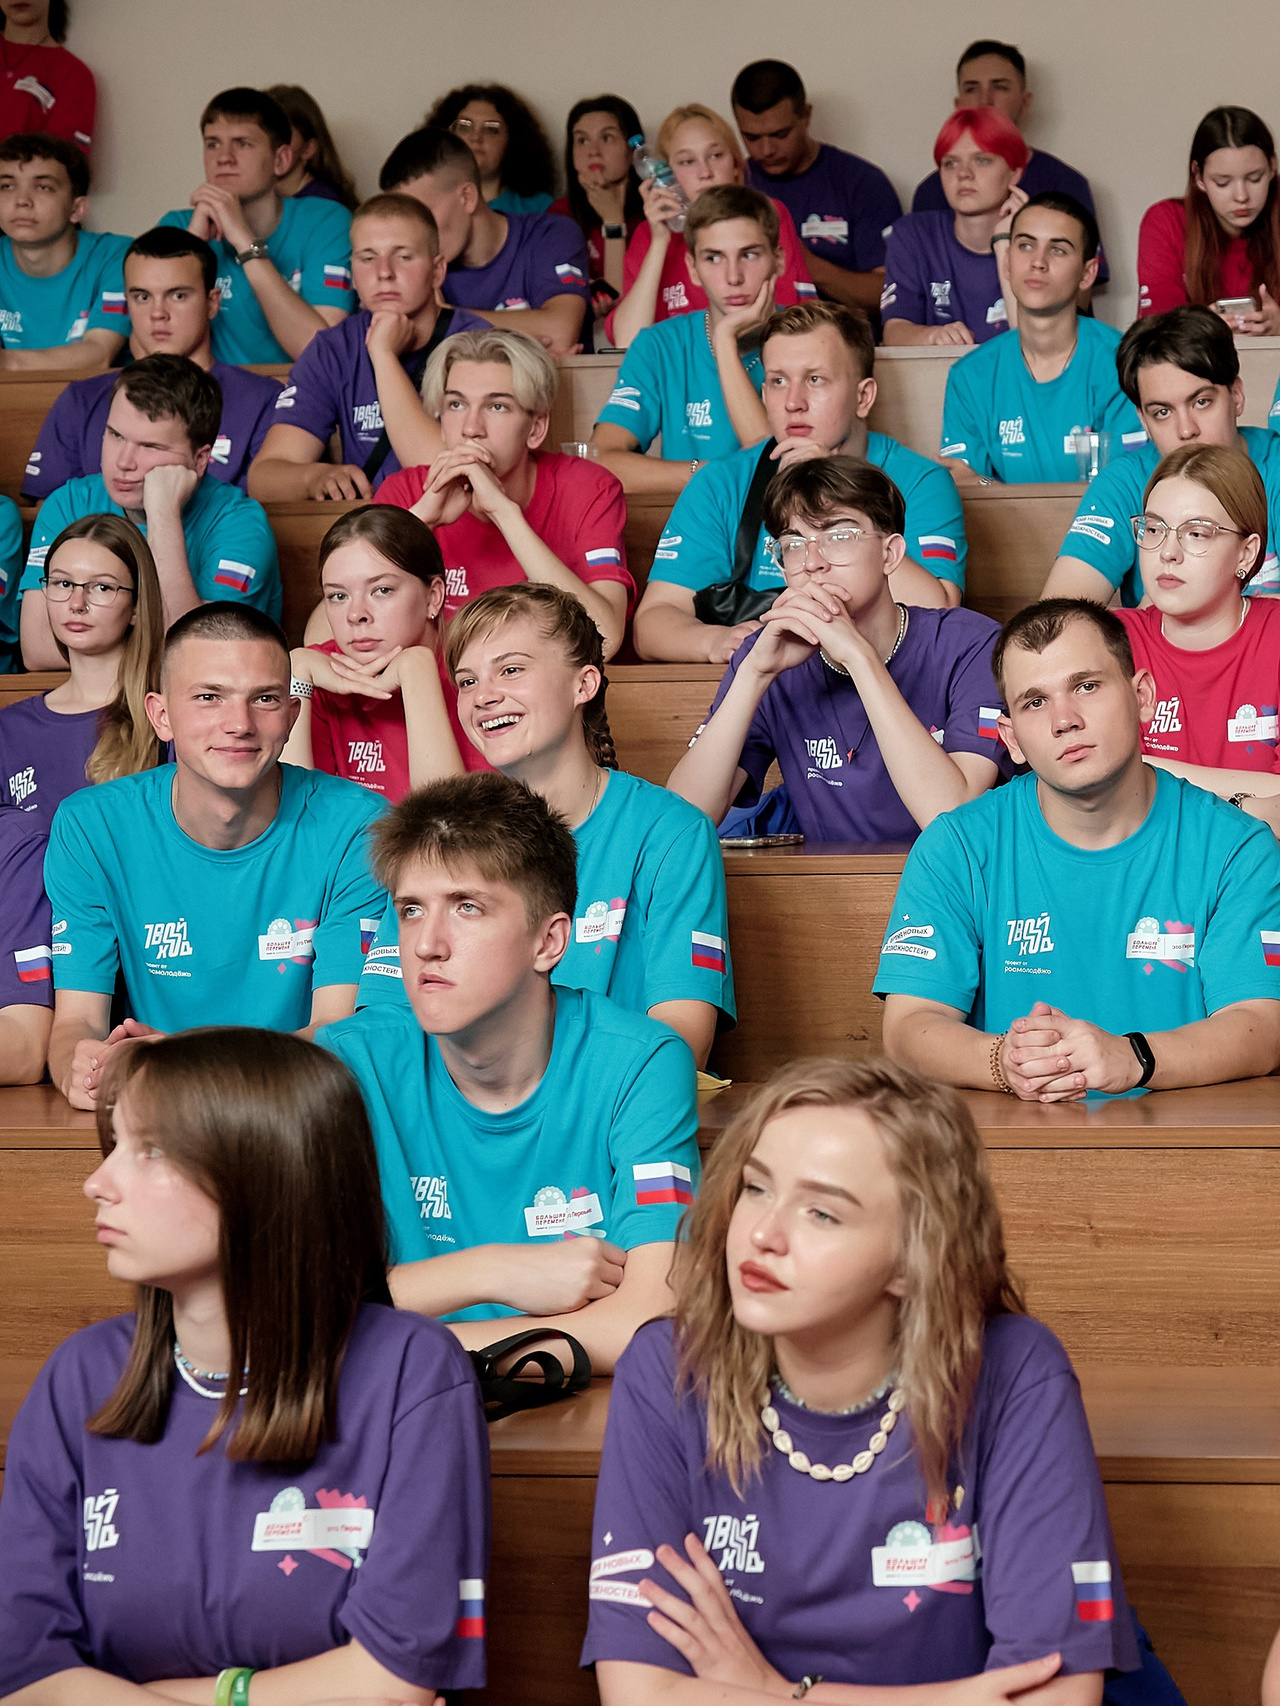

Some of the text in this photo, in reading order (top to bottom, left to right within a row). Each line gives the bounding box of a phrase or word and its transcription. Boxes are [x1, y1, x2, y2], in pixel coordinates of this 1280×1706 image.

[348, 739, 382, 763] ТВОЙ
[804, 736, 837, 758] ТВОЙ
[357, 758, 386, 773] ХОД
[815, 754, 843, 770] ХОД
[144, 917, 188, 950] ТВОЙ
[1006, 912, 1051, 946] ТВОЙ
[156, 940, 193, 960] ХОД
[371, 948, 398, 958] НОВЫХ
[1018, 937, 1055, 956] ХОД
[420, 1199, 452, 1219] ХОД
[702, 1513, 761, 1554] ТВОЙ
[605, 1555, 642, 1570] НОВЫХ
[718, 1547, 766, 1574] ХОД
